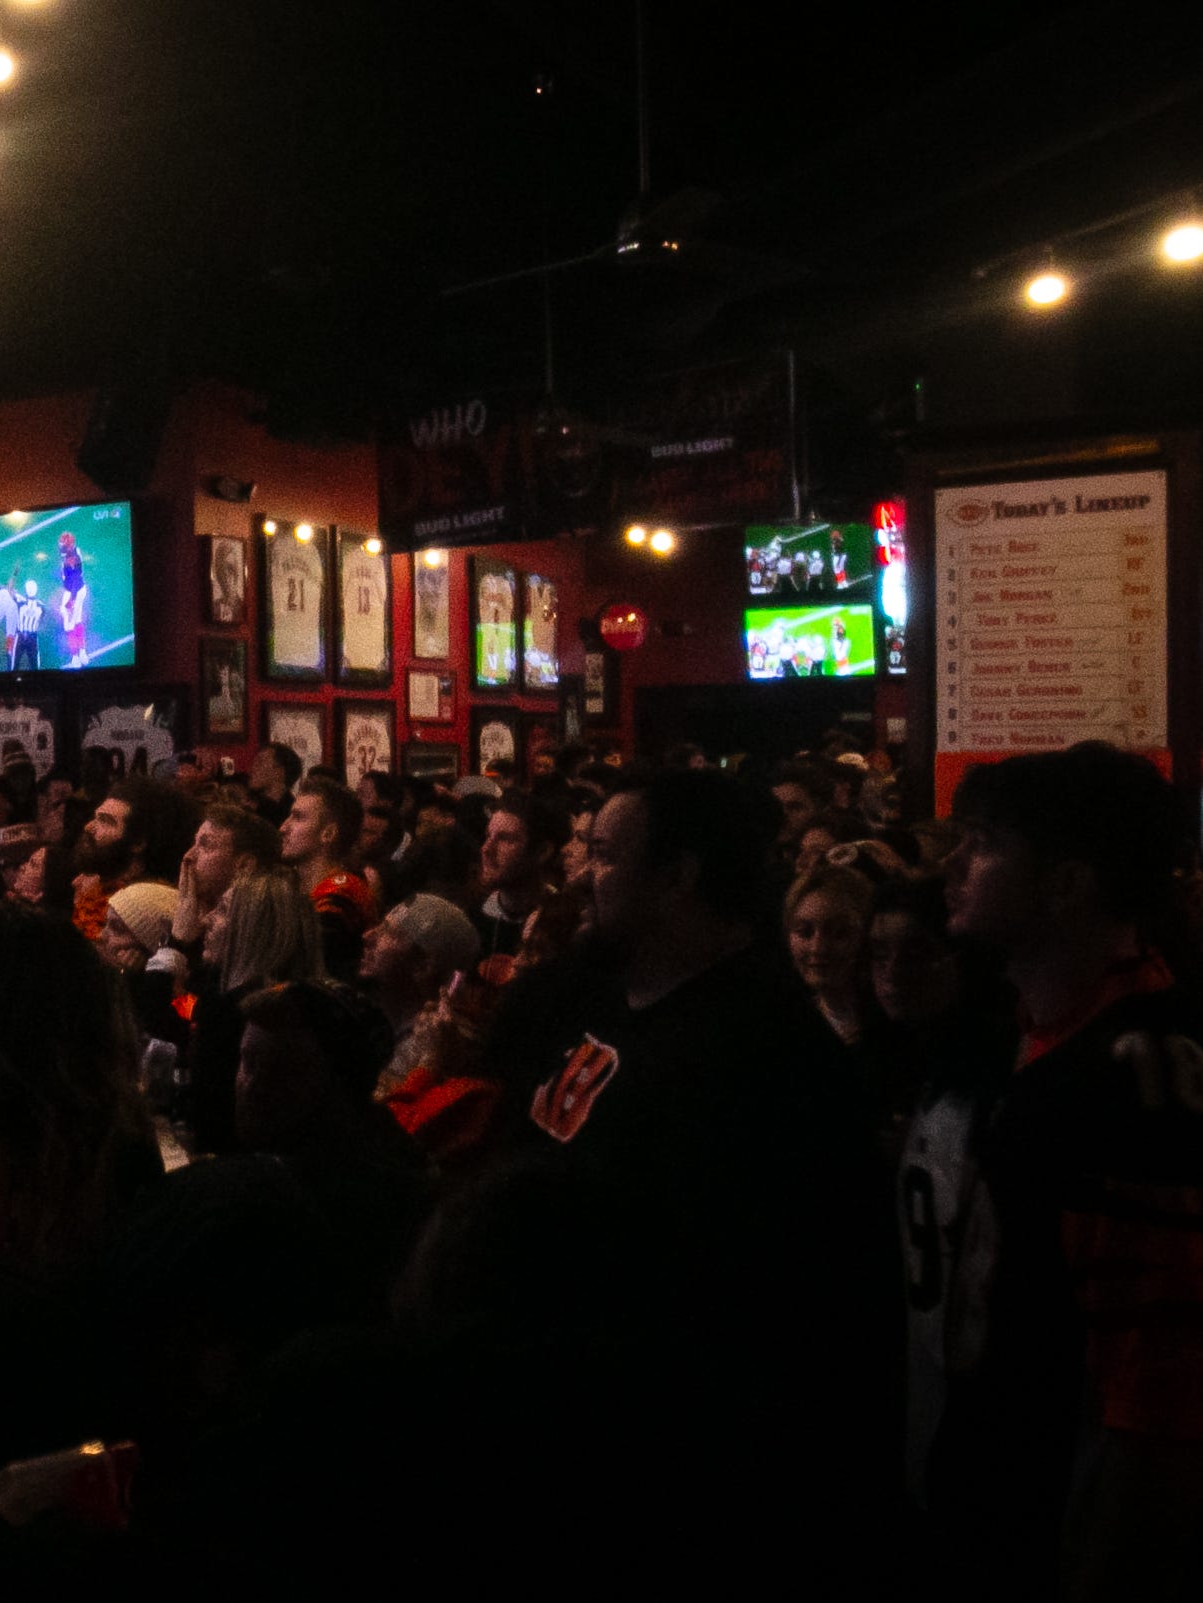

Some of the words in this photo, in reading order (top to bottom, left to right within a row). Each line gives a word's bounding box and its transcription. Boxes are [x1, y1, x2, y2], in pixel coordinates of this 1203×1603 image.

[410, 398, 487, 449] WHO
[686, 435, 735, 455] LIGHT
[413, 516, 451, 537] BUD
[453, 505, 506, 528] LIGHT
[992, 497, 1067, 520] TODAY'S
[1075, 494, 1151, 514] LINEUP
